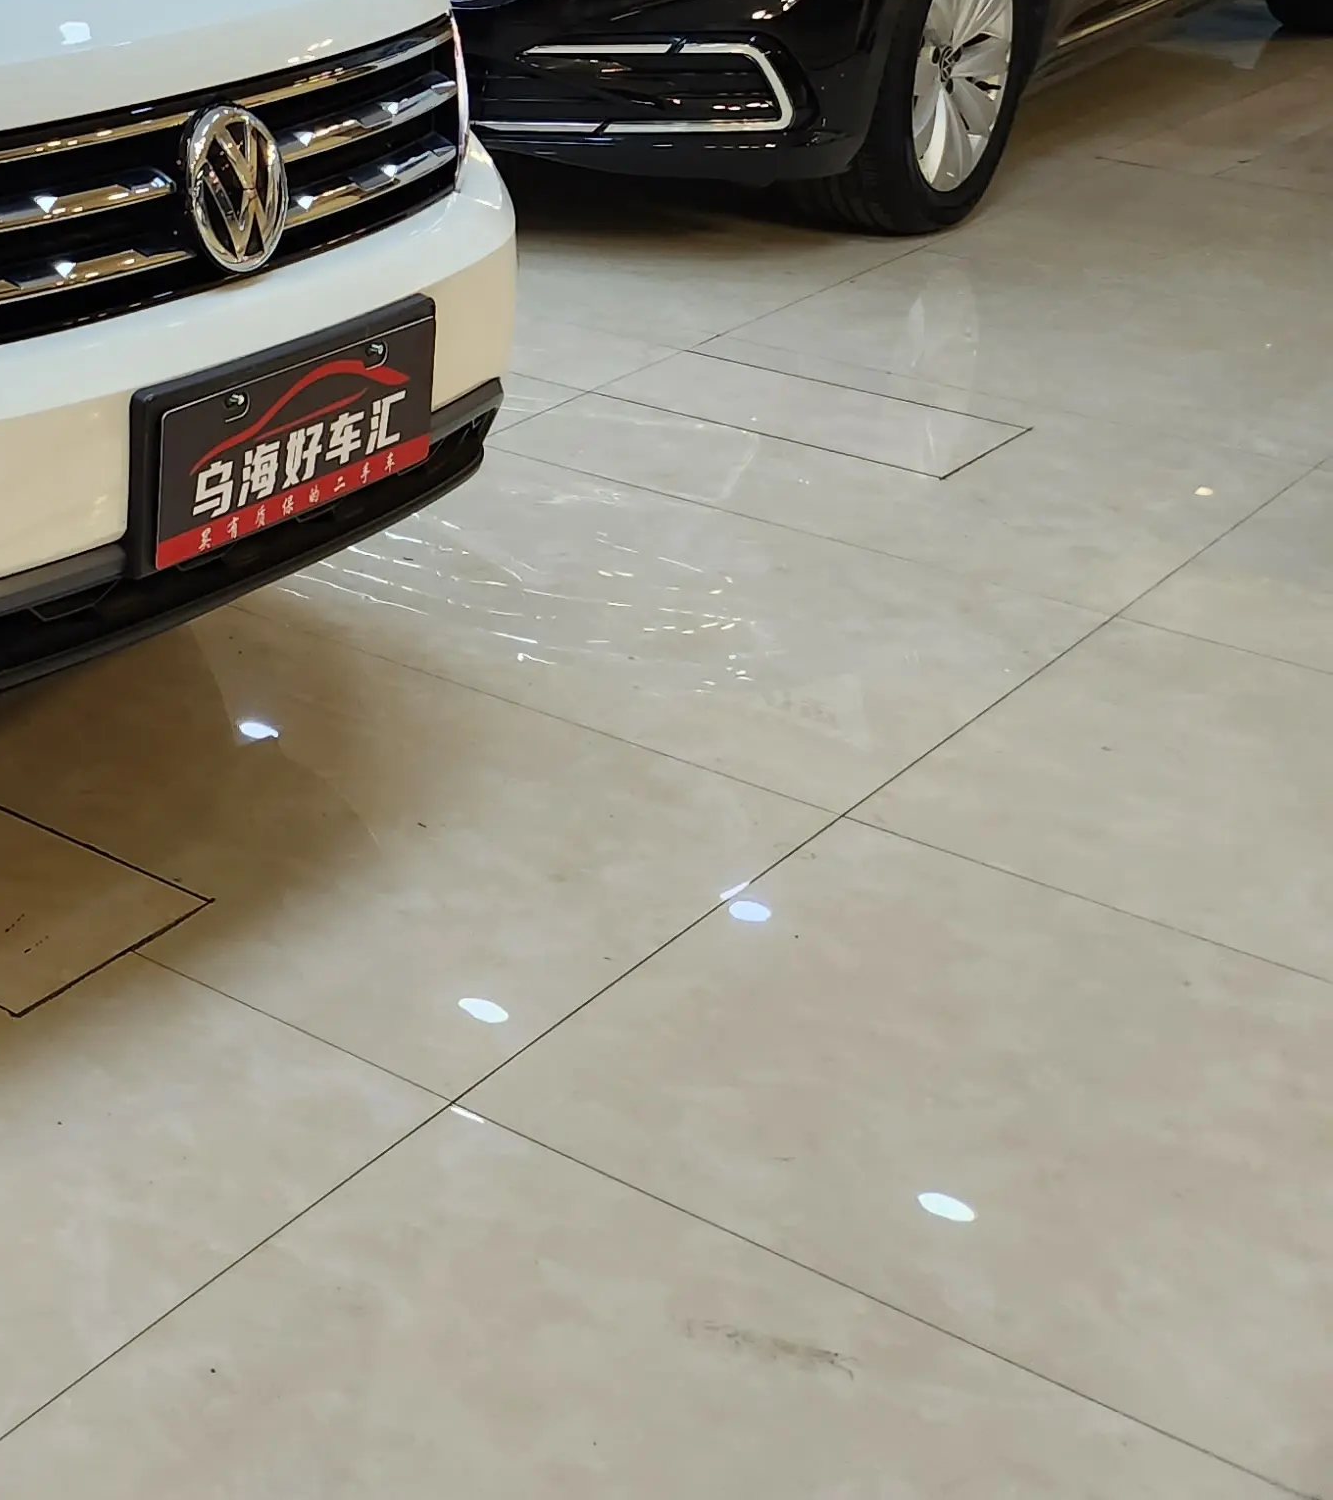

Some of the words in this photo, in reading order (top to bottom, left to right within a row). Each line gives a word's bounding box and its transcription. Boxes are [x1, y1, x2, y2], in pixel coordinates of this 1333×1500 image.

[192, 390, 407, 518] 乌海好车汇
[198, 451, 396, 551] 买有质保的二手车
